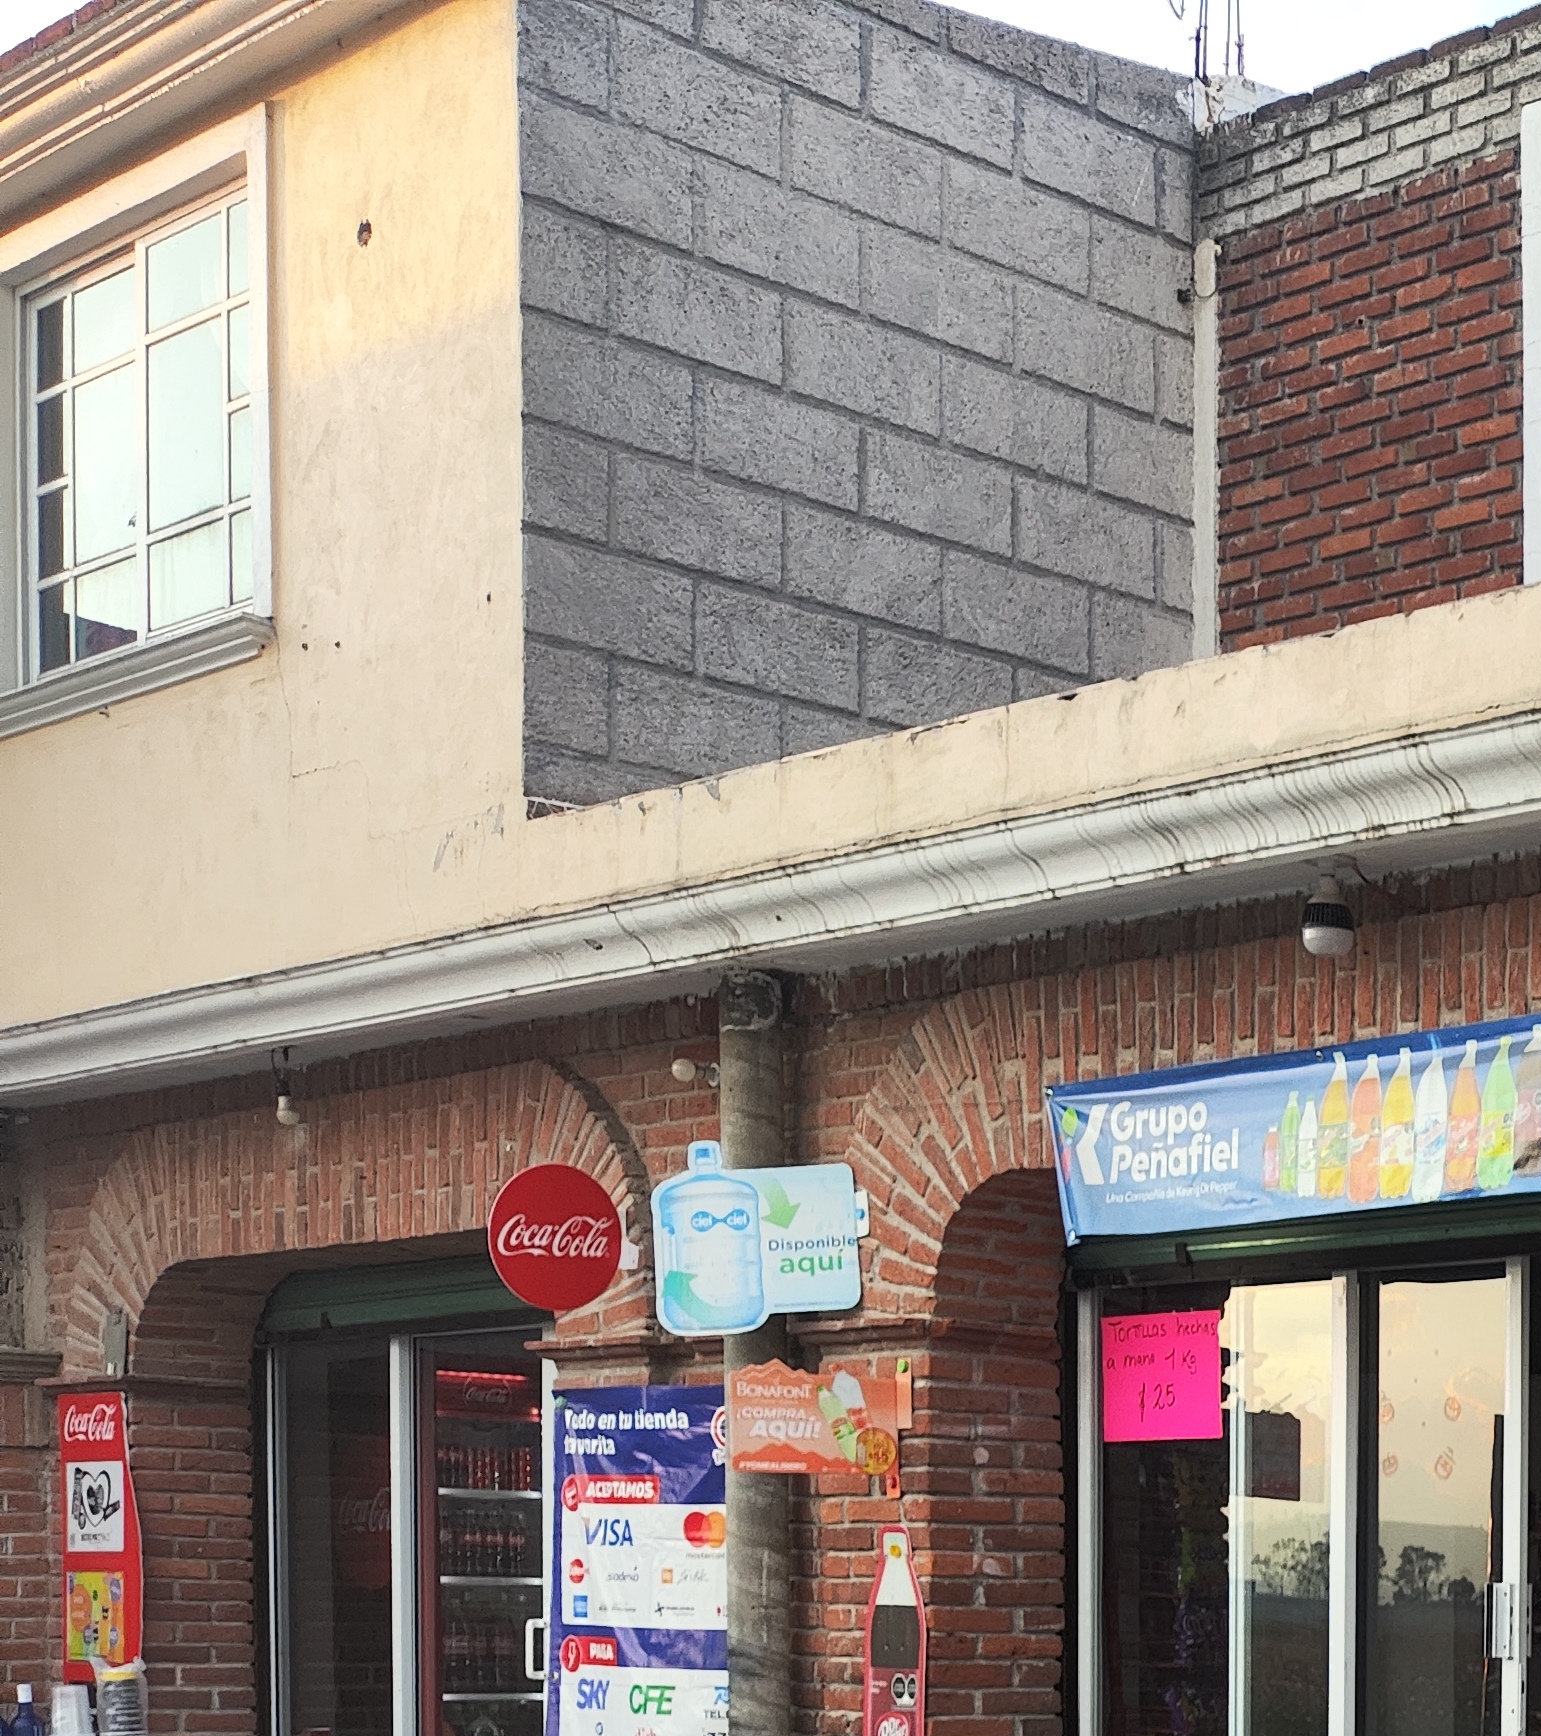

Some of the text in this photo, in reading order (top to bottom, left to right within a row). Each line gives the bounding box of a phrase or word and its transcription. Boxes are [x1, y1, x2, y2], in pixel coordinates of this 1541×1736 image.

[1110, 1101, 1208, 1146] Grupo
[1109, 1126, 1240, 1185] Peñafiel
[692, 1212, 747, 1229] ciel ciel
[497, 1213, 613, 1258] Coca-Cola
[768, 1234, 857, 1252] Disponible
[779, 1250, 844, 1277] aquí
[1124, 1353, 1155, 1368] mano
[1165, 1348, 1175, 1371] 1
[736, 1381, 813, 1399] BONAFONT
[64, 1403, 116, 1442] Coca-Cola
[598, 1412, 616, 1430] en
[618, 1409, 633, 1430] tu
[634, 1407, 690, 1430] tienda
[583, 1517, 634, 1547] VISA
[576, 1678, 676, 1716] SKY CFE
